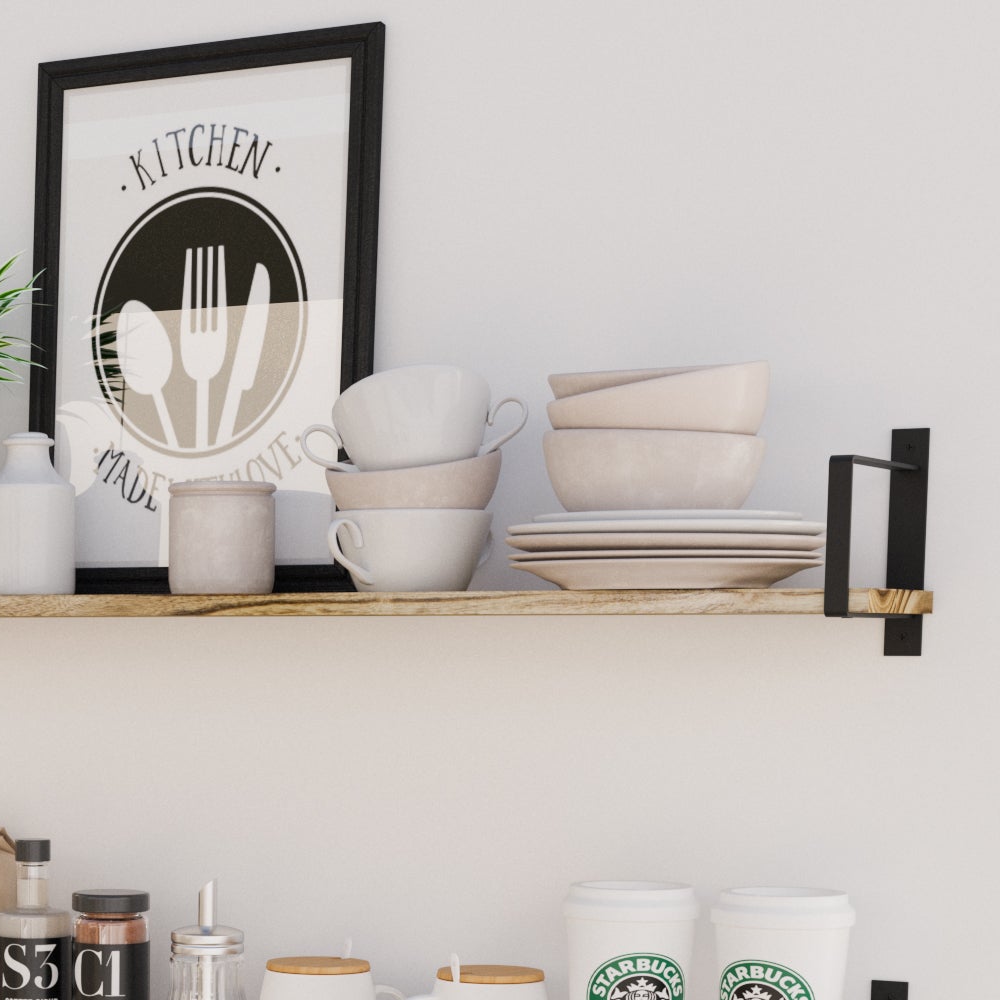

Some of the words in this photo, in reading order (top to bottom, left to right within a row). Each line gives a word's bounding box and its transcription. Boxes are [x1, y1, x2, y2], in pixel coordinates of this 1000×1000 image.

[129, 124, 273, 190] KITCHEN
[93, 441, 165, 512] MADE
[2, 943, 59, 990] S3
[74, 949, 126, 997] C1
[592, 958, 683, 998] STARBUCKS
